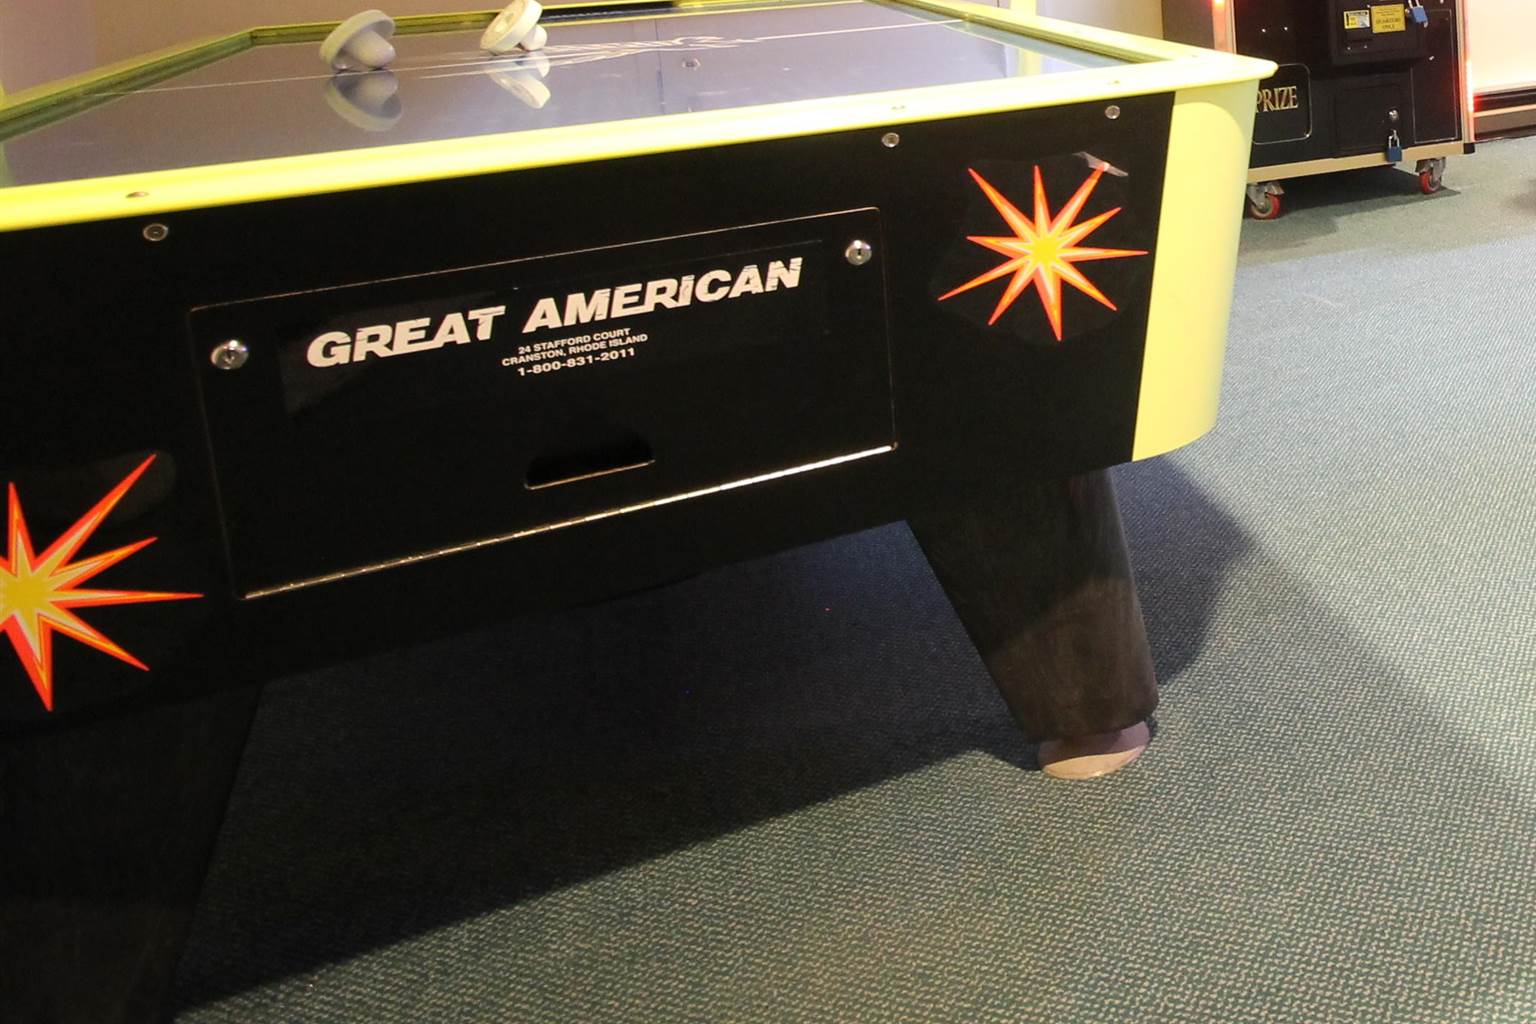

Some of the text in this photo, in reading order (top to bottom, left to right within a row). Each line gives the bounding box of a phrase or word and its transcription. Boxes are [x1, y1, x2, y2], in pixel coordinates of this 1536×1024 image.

[306, 257, 804, 369] GREAT AMERICAN
[518, 327, 632, 355] 24 STAFFORD COURT
[568, 340, 608, 355] RHODE
[608, 333, 649, 348] ISLAND
[517, 347, 636, 377] 1-800-831-2011
